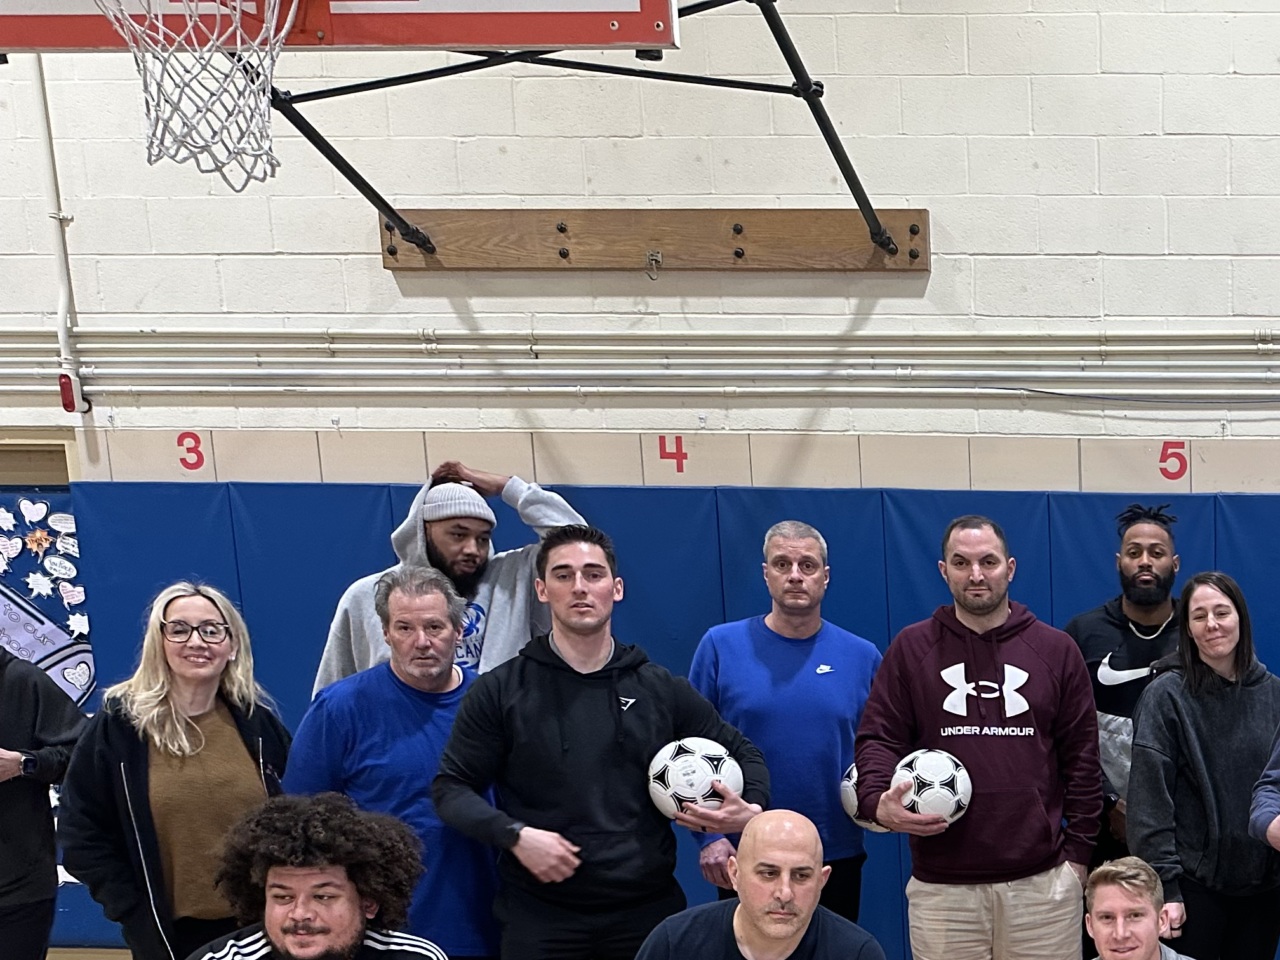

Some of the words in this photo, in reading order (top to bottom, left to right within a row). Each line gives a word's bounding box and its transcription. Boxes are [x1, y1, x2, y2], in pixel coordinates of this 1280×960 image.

[177, 432, 205, 471] 3
[659, 436, 688, 472] 4
[1159, 441, 1187, 480] 5
[940, 725, 980, 737] UNDER
[981, 726, 1035, 737] ARMOUR
